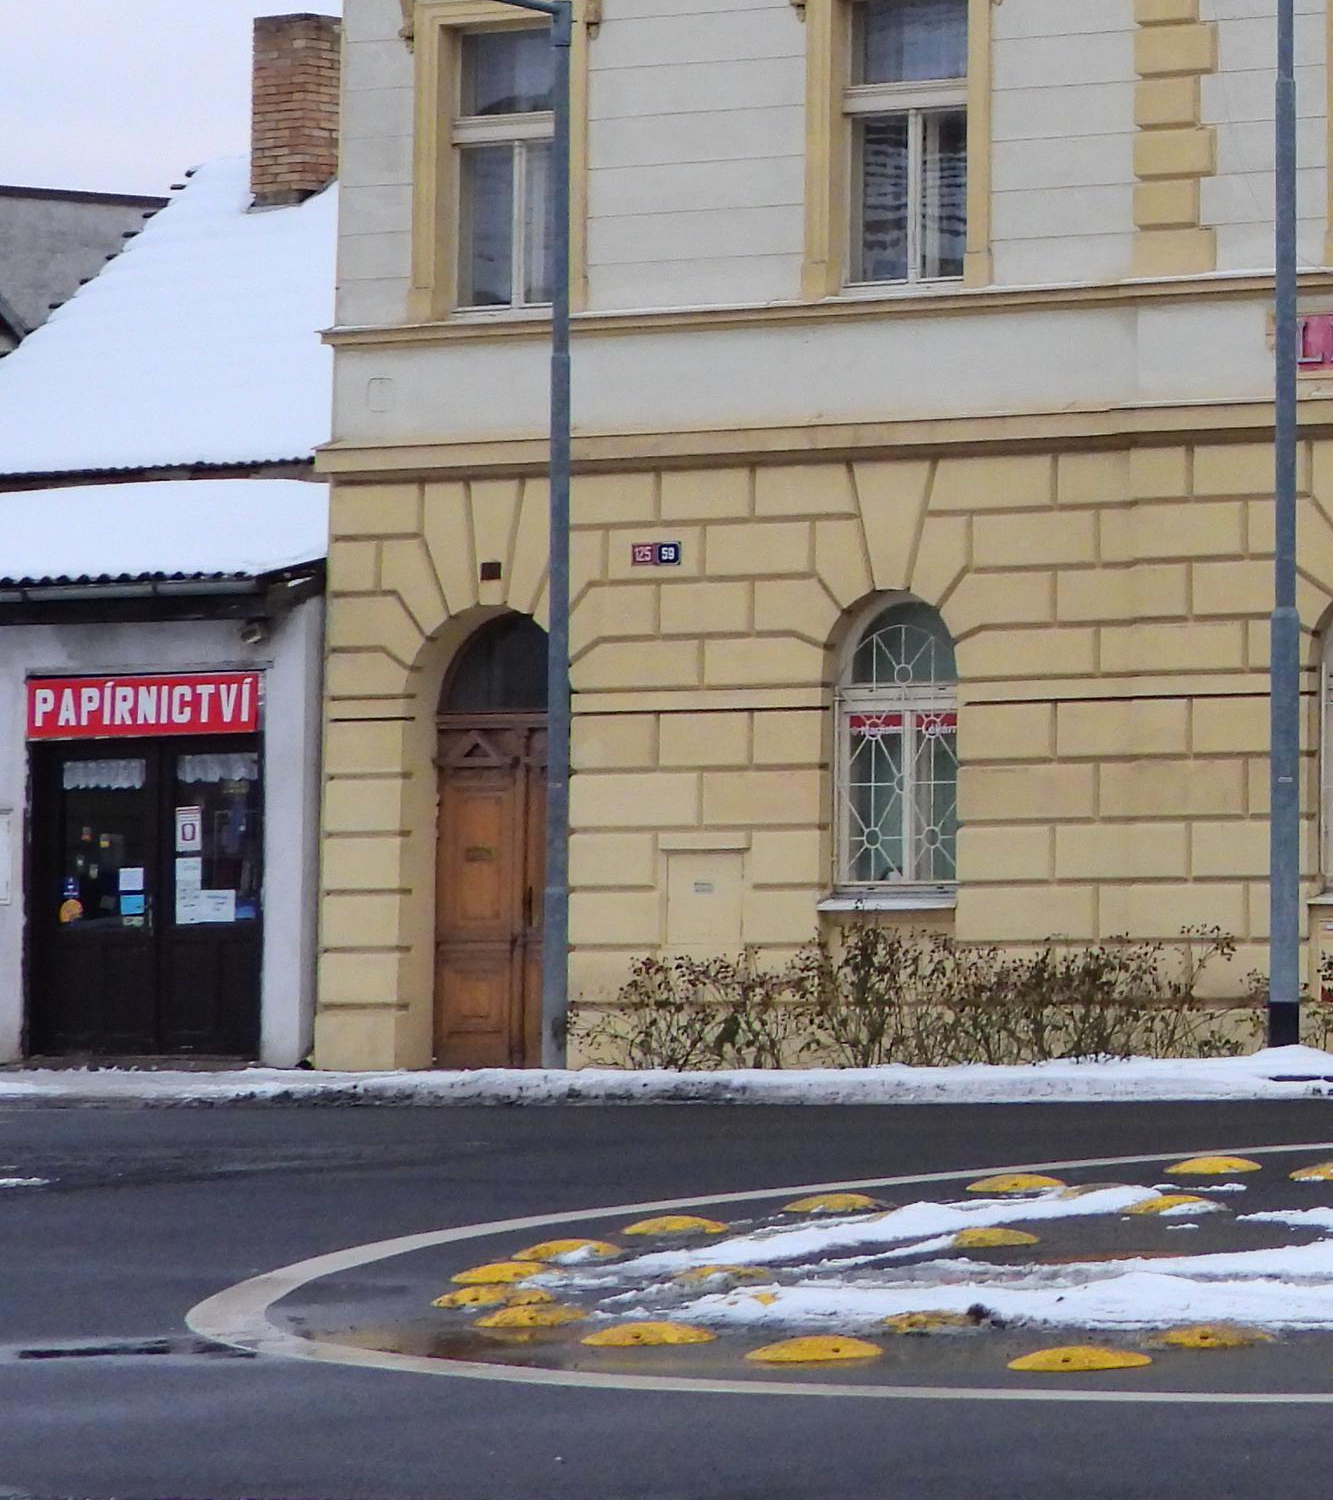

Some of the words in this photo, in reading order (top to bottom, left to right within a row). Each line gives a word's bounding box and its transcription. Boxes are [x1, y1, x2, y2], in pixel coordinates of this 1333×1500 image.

[635, 546, 652, 562] 125
[661, 546, 675, 560] 59
[34, 678, 252, 727] PAPÍRNICTVÍ
